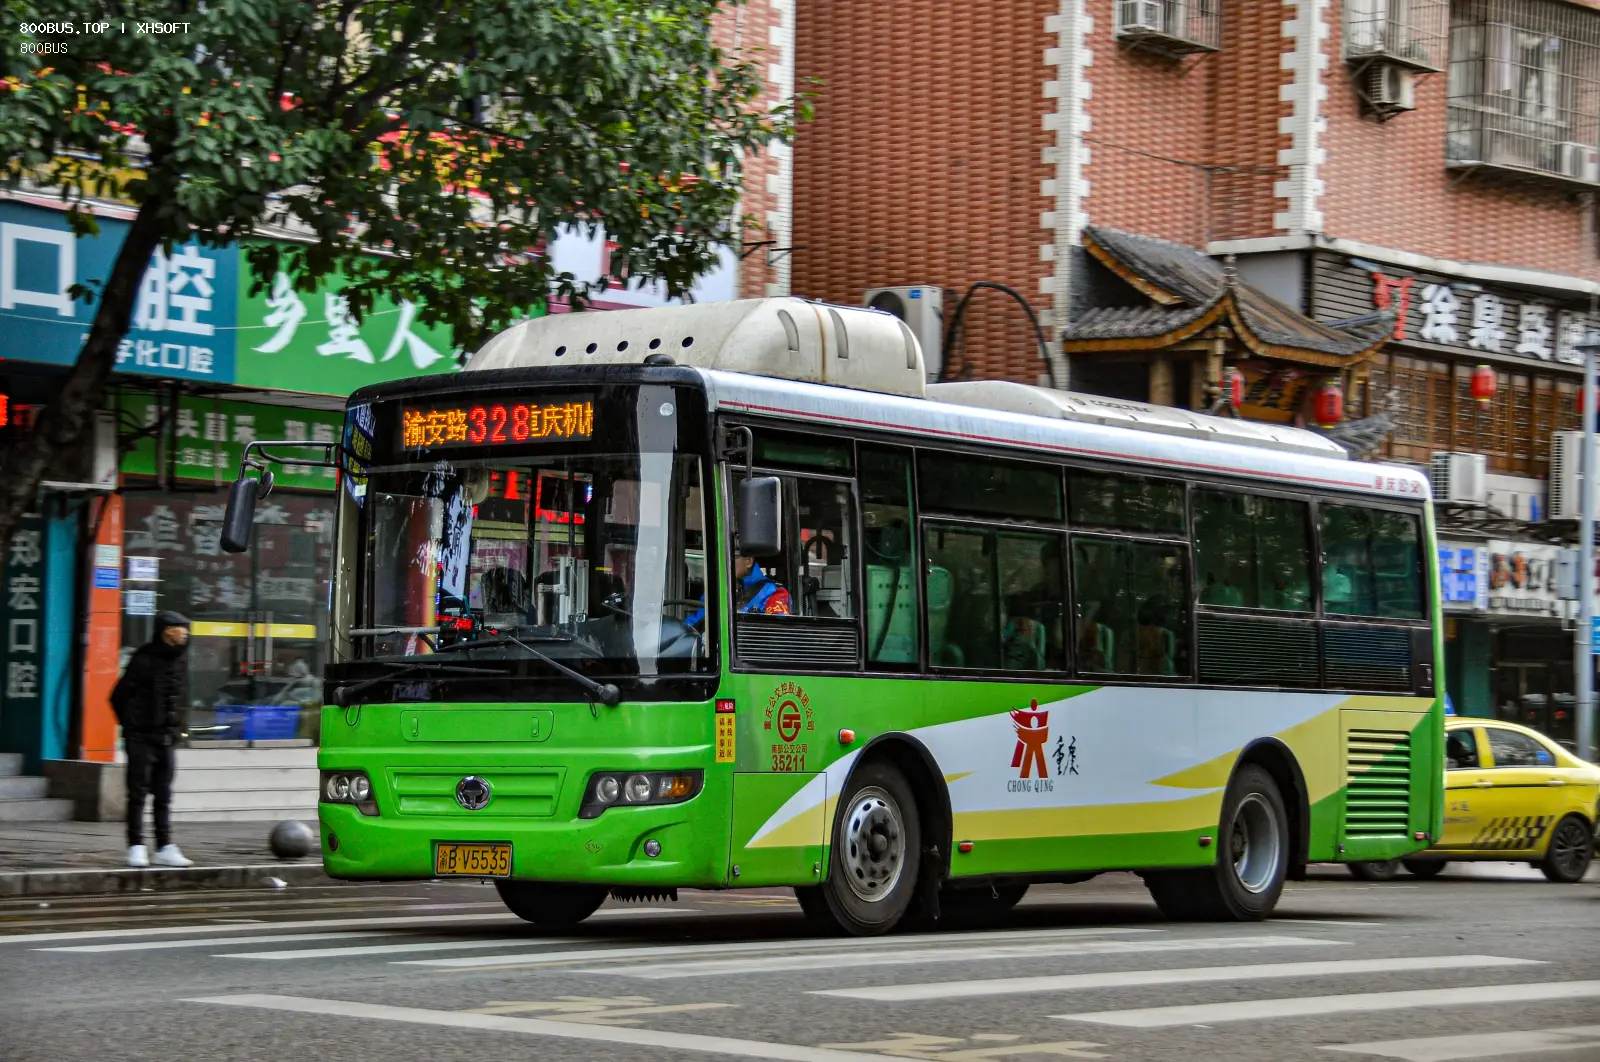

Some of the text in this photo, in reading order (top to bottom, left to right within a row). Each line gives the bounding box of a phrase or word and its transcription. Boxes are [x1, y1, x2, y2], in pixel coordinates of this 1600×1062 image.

[404, 409, 468, 447] 渝安路
[469, 404, 530, 443] 328
[771, 744, 808, 754] 南部公交公司
[771, 755, 805, 771] 35211
[1007, 780, 1054, 793] CHONG QING
